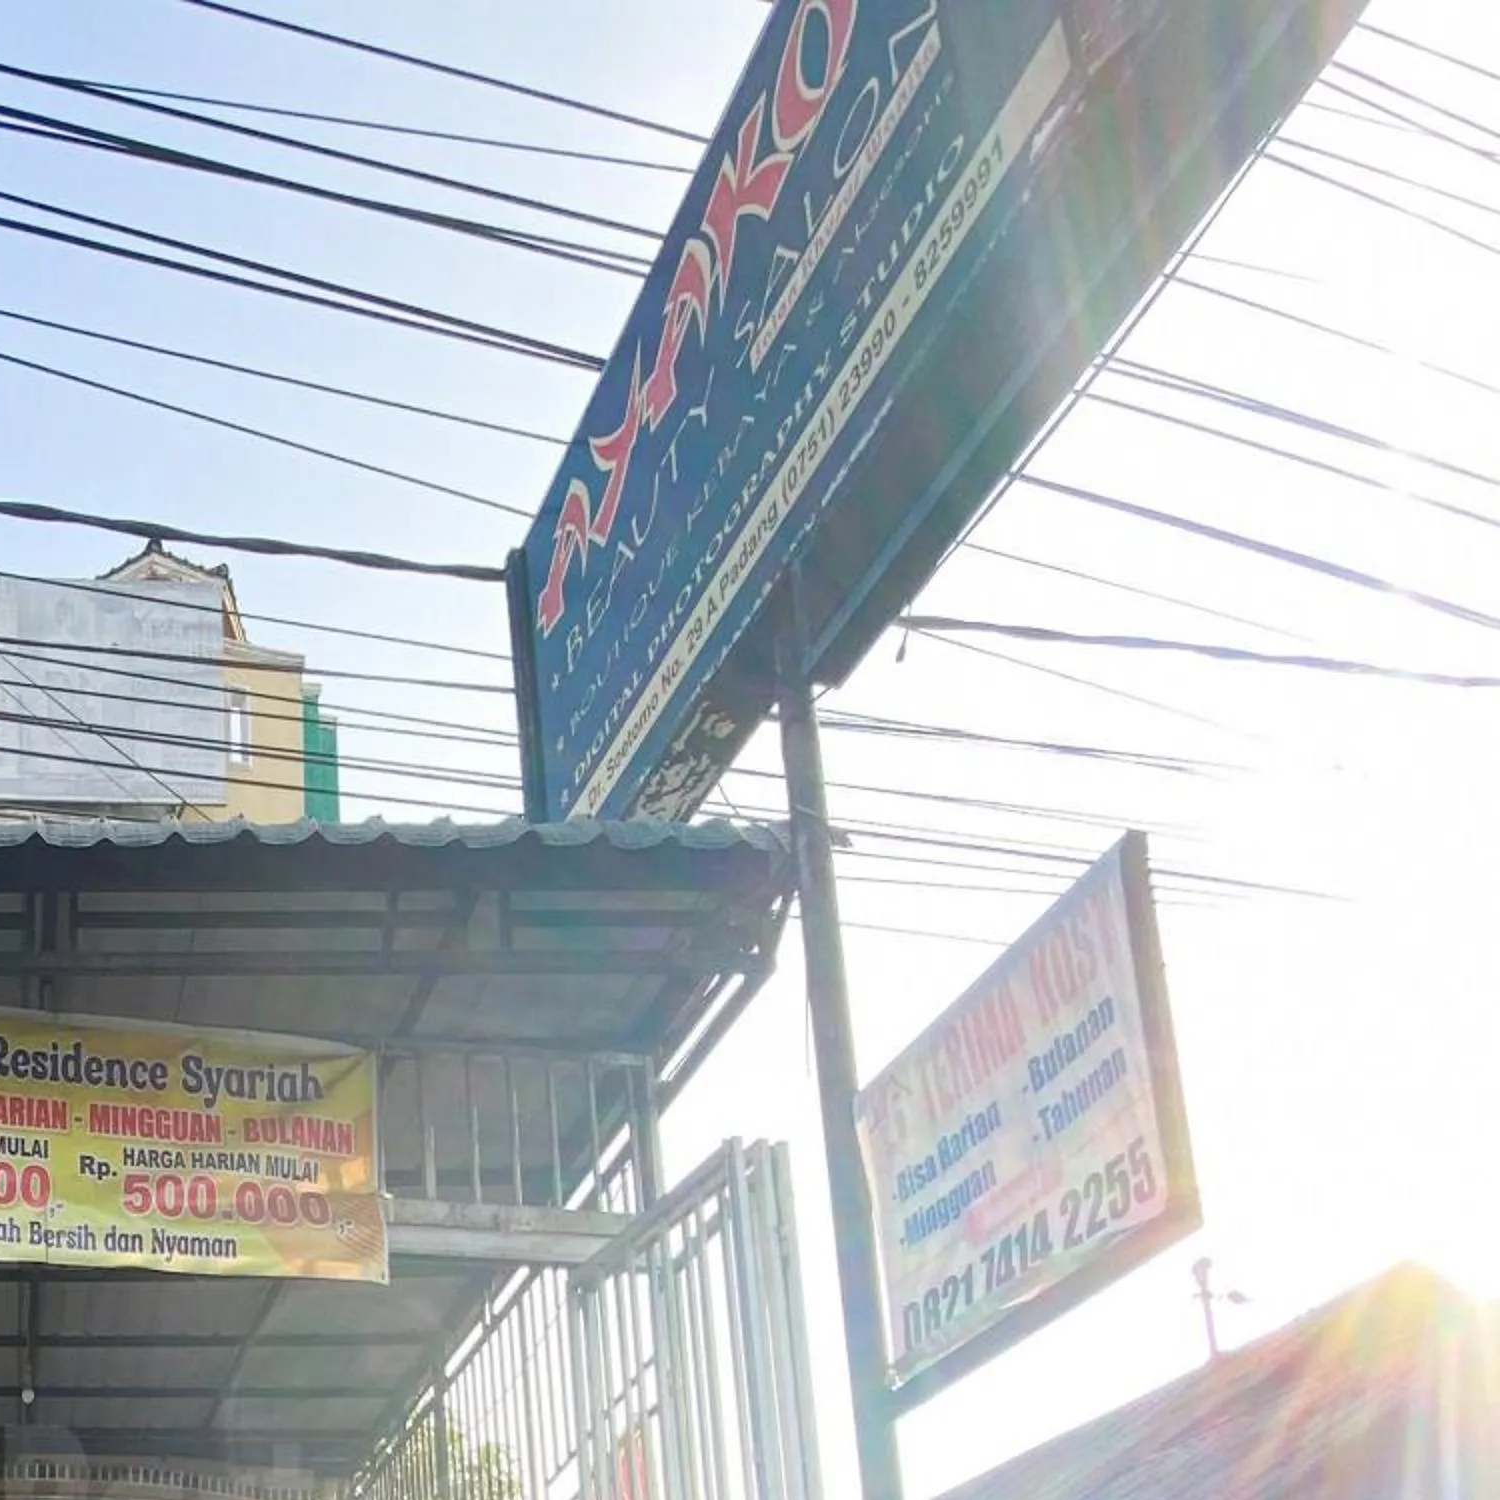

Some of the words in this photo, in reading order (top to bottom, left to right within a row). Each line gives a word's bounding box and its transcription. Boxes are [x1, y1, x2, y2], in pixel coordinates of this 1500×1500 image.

[565, 365, 715, 673] BEAUTY
[733, 0, 940, 369] SALON
[660, 657, 685, 696] No.
[703, 600, 719, 629] A
[717, 505, 780, 600] Padang
[781, 405, 837, 507] (0751)
[838, 307, 898, 412] 23990
[912, 131, 1007, 292] 8259991
[574, 670, 644, 786] DIGITAL
[647, 350, 832, 664] PHOTOGRAPHY
[840, 133, 964, 347] STUDIO
[181, 1056, 324, 1108] Syariah
[918, 978, 1028, 1118] TERIMA
[89, 1103, 223, 1144] MINGGUAN
[243, 1116, 354, 1154] BULANAN
[122, 1148, 186, 1170] HARGA
[192, 1151, 261, 1175] HARIAN
[265, 1156, 319, 1184] MULAI
[936, 1101, 1003, 1176] Harian
[79, 1154, 117, 1180] Rp.
[29, 1222, 96, 1251] Bersih
[104, 1225, 143, 1254] dan
[151, 1227, 238, 1262] Nyaman
[902, 1265, 975, 1352] 0821
[980, 1208, 1054, 1294] 7414
[1059, 1136, 1160, 1250] 2255
